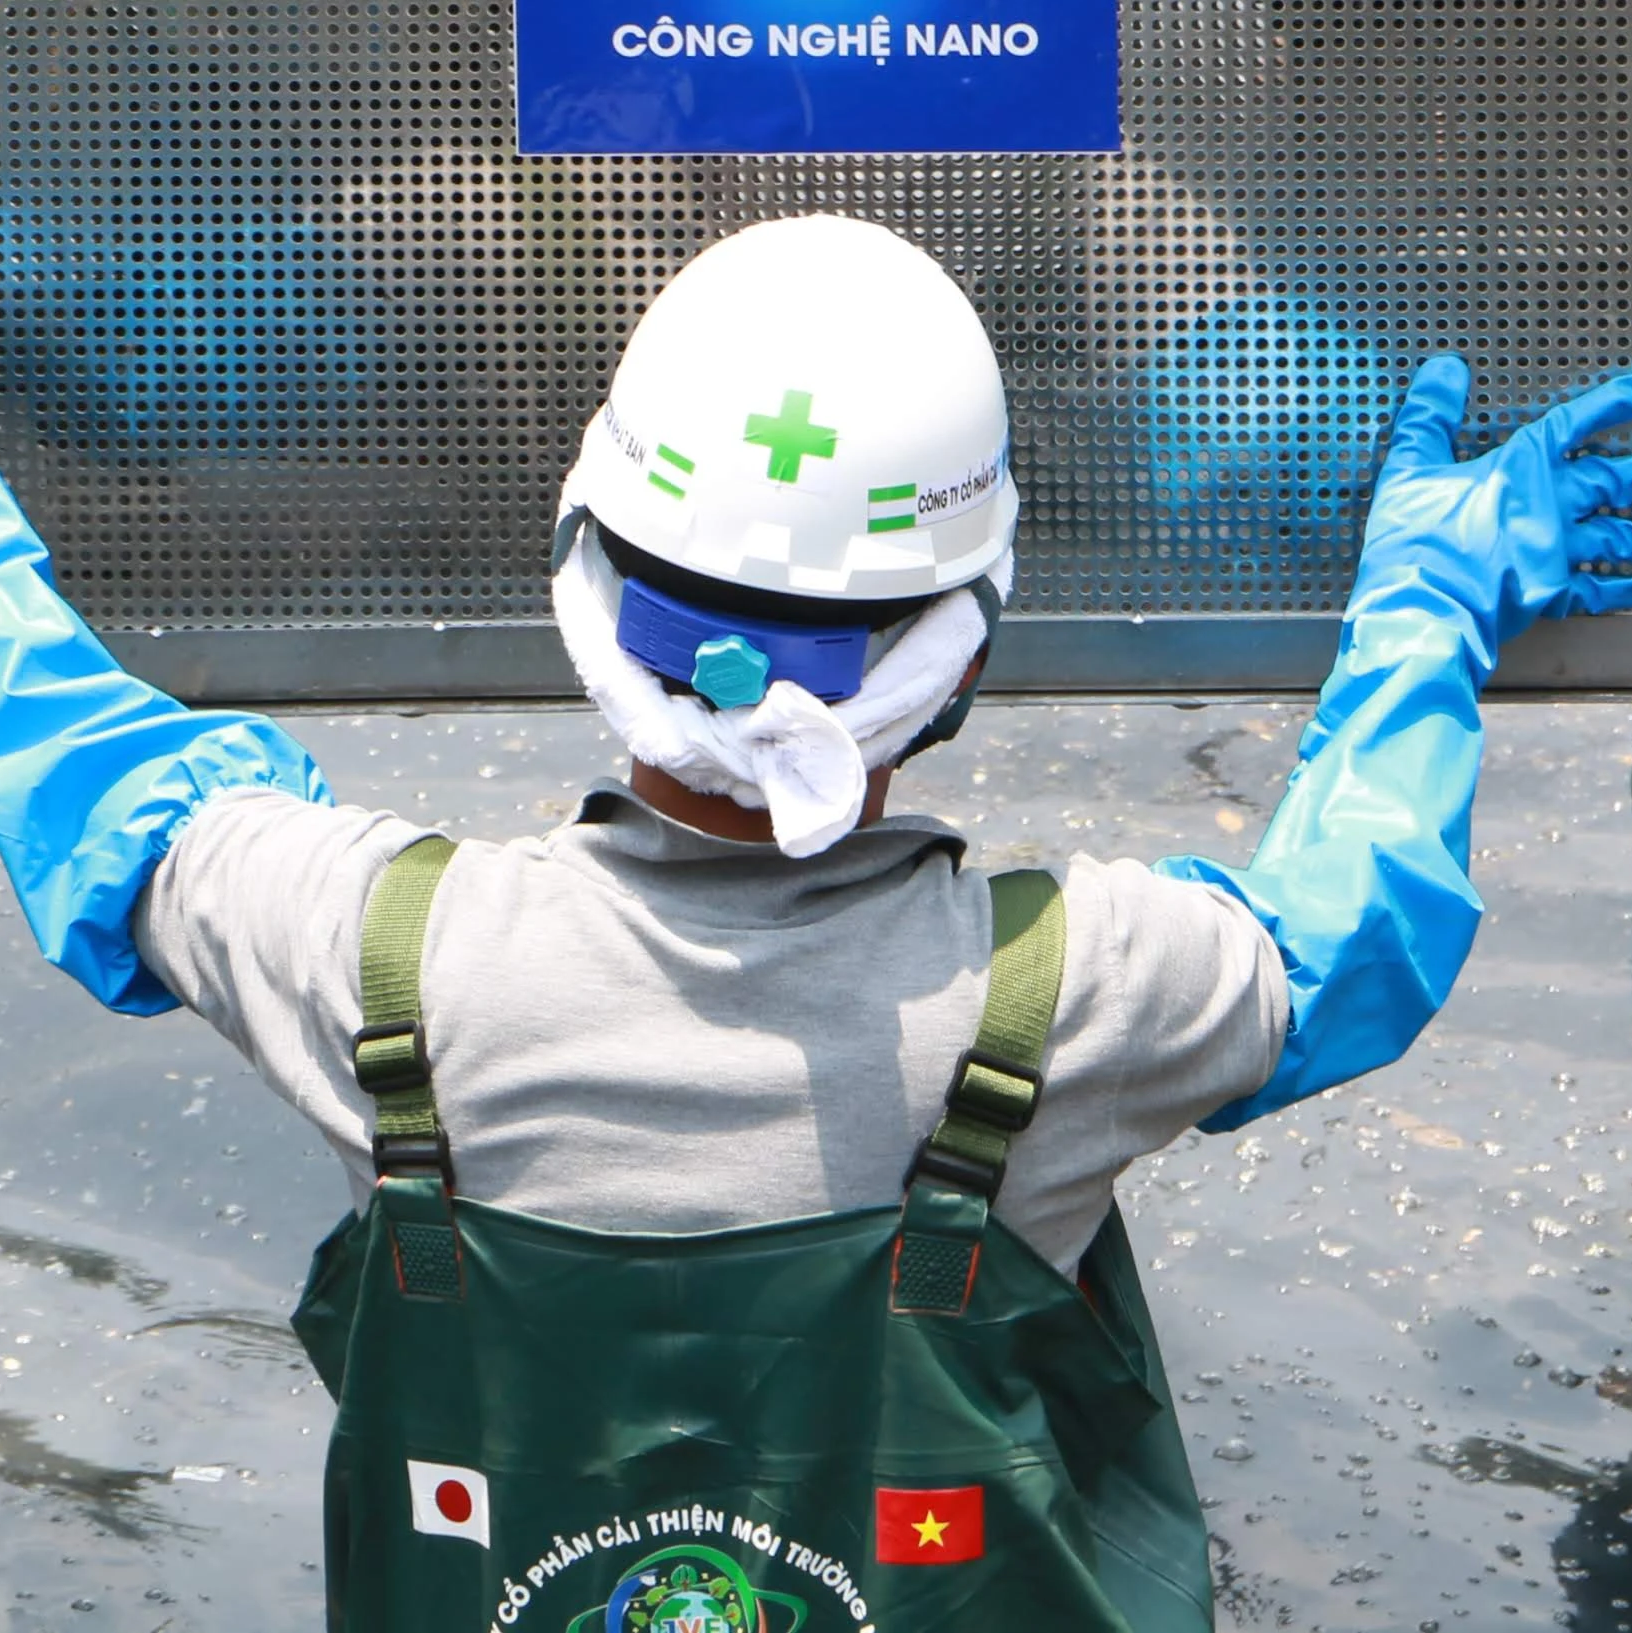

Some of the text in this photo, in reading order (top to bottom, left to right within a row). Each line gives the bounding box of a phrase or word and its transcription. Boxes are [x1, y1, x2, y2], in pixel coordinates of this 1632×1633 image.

[612, 16, 1040, 66] CÔNG NGHỆ NANO
[917, 487, 948, 514] CÔNG
[950, 486, 960, 507] TY
[498, 1503, 868, 1624] CỔ PHẦN CẢI THIỆN MÔI TRƯỜNG
